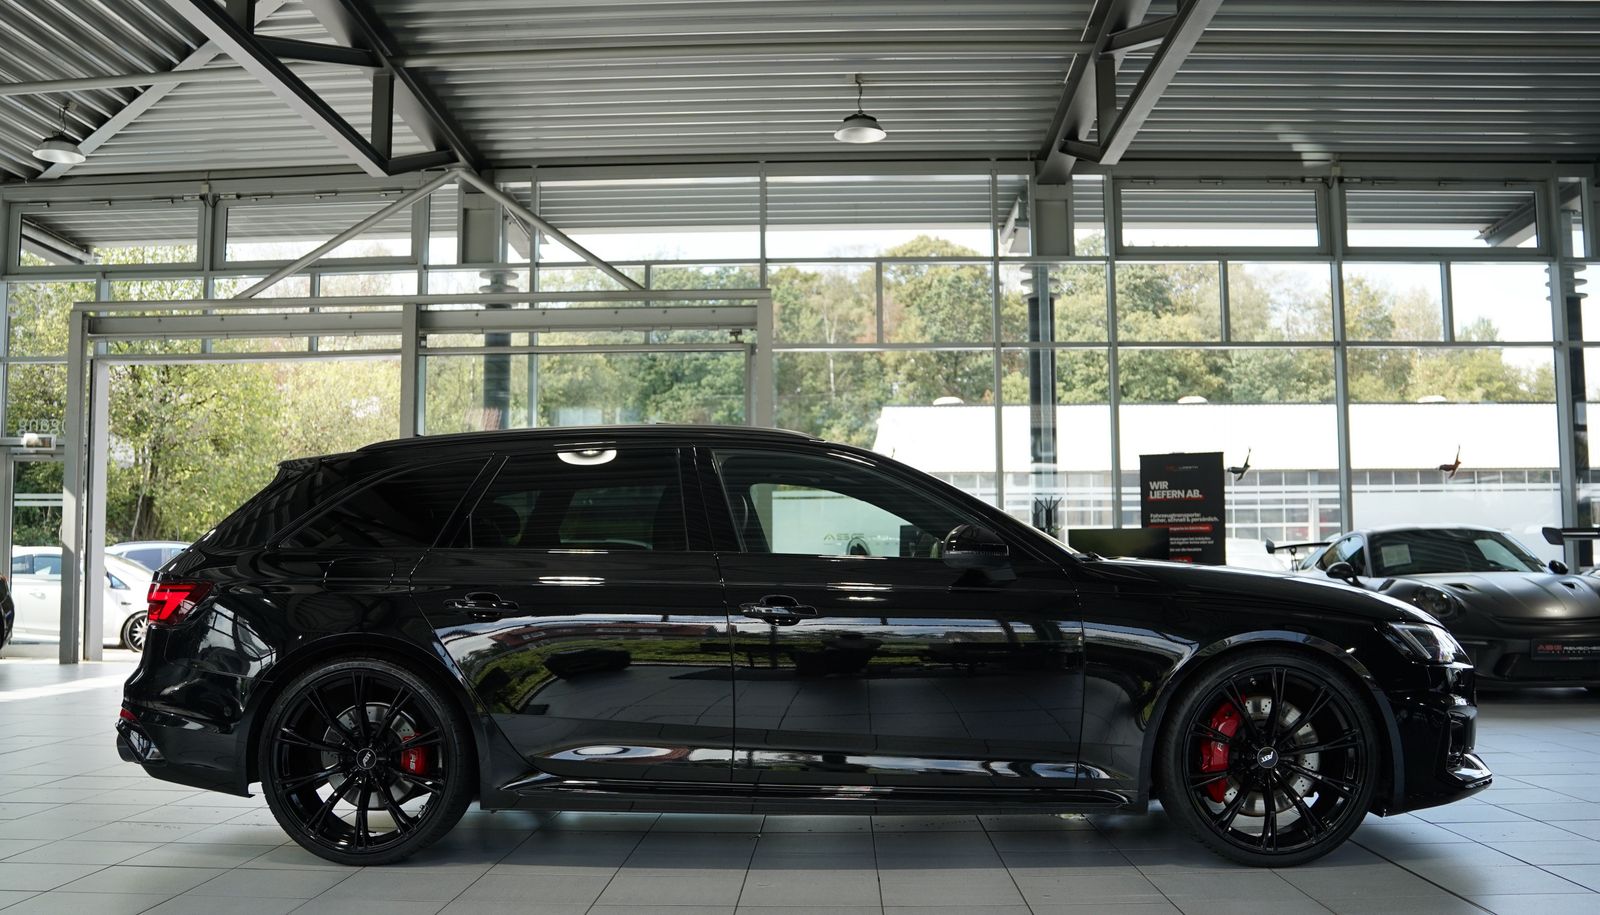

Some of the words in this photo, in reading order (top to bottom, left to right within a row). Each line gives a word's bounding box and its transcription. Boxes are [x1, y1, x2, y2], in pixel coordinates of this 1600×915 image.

[1149, 481, 1169, 489] WIR
[1149, 490, 1185, 499] LIEFERN
[1187, 489, 1203, 498] AB.
